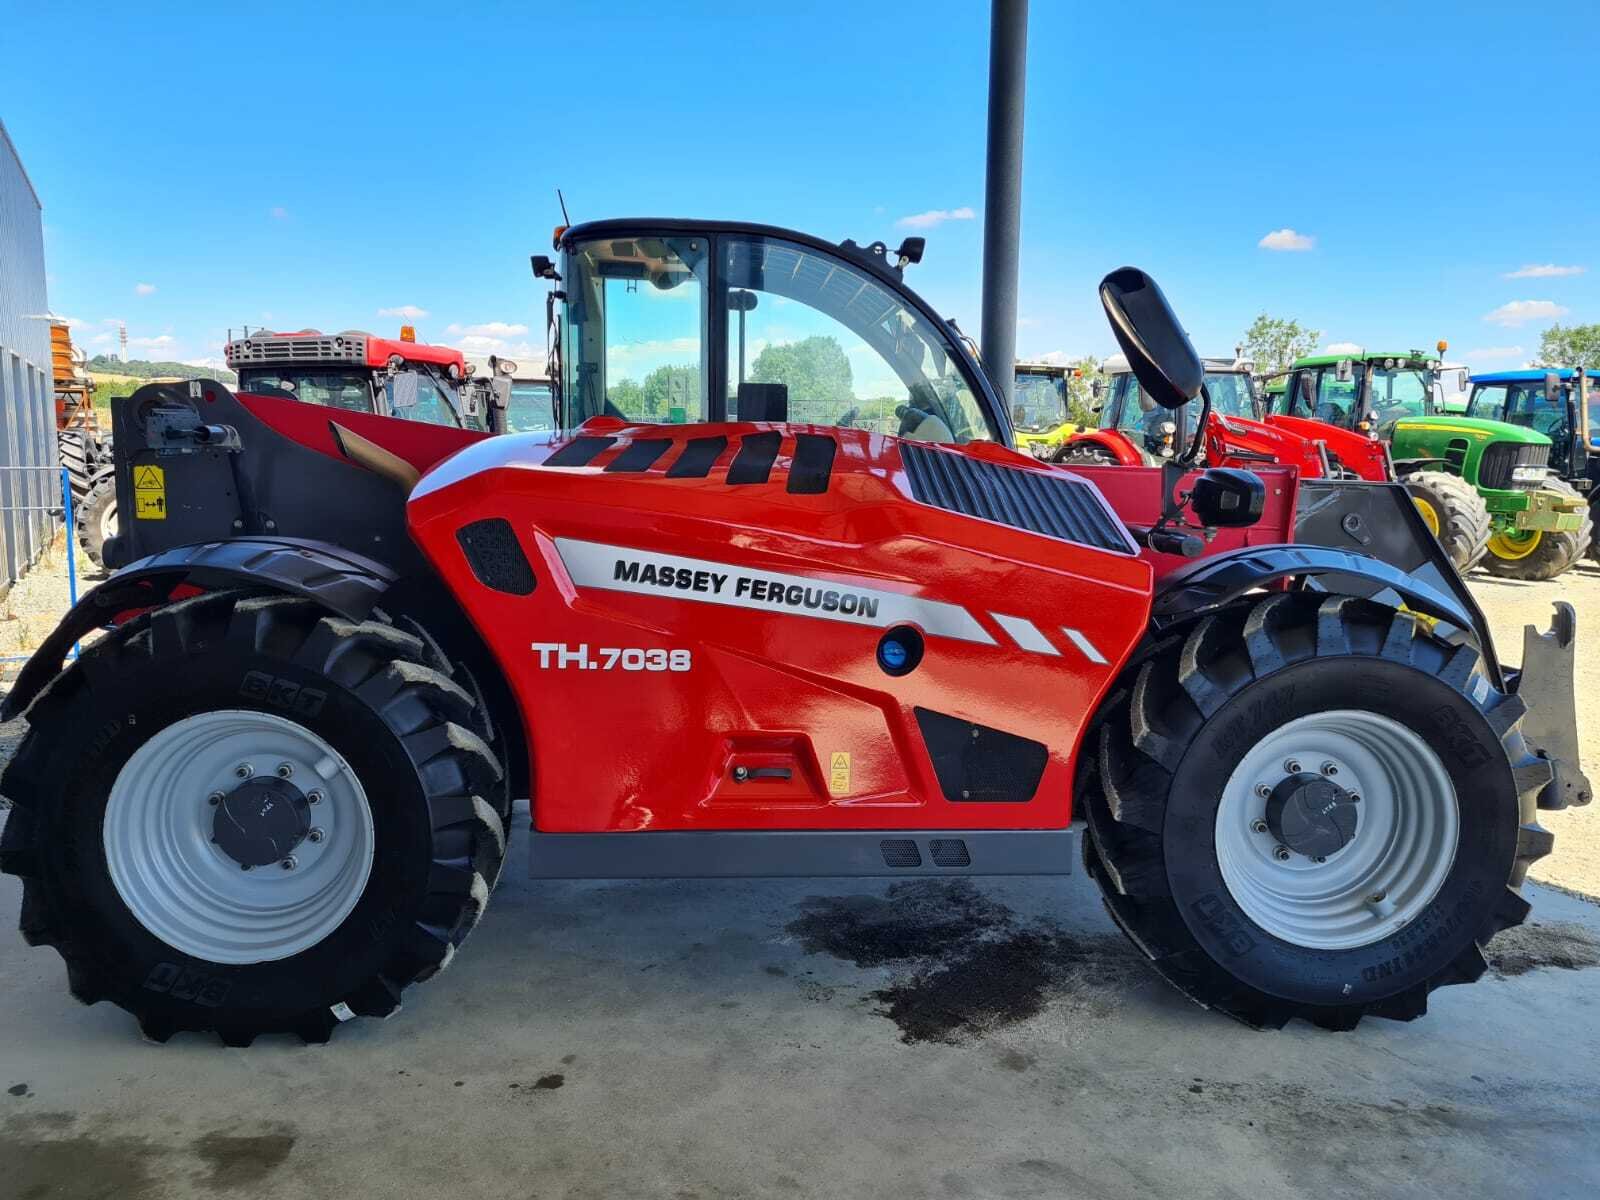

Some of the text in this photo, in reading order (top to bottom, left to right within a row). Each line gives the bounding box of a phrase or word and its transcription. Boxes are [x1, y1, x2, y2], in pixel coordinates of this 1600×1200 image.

[614, 560, 880, 618] MASSEY FERGUSON
[531, 642, 692, 671] TH.7038
[241, 671, 328, 717] BKT
[144, 962, 231, 1007] BKT
